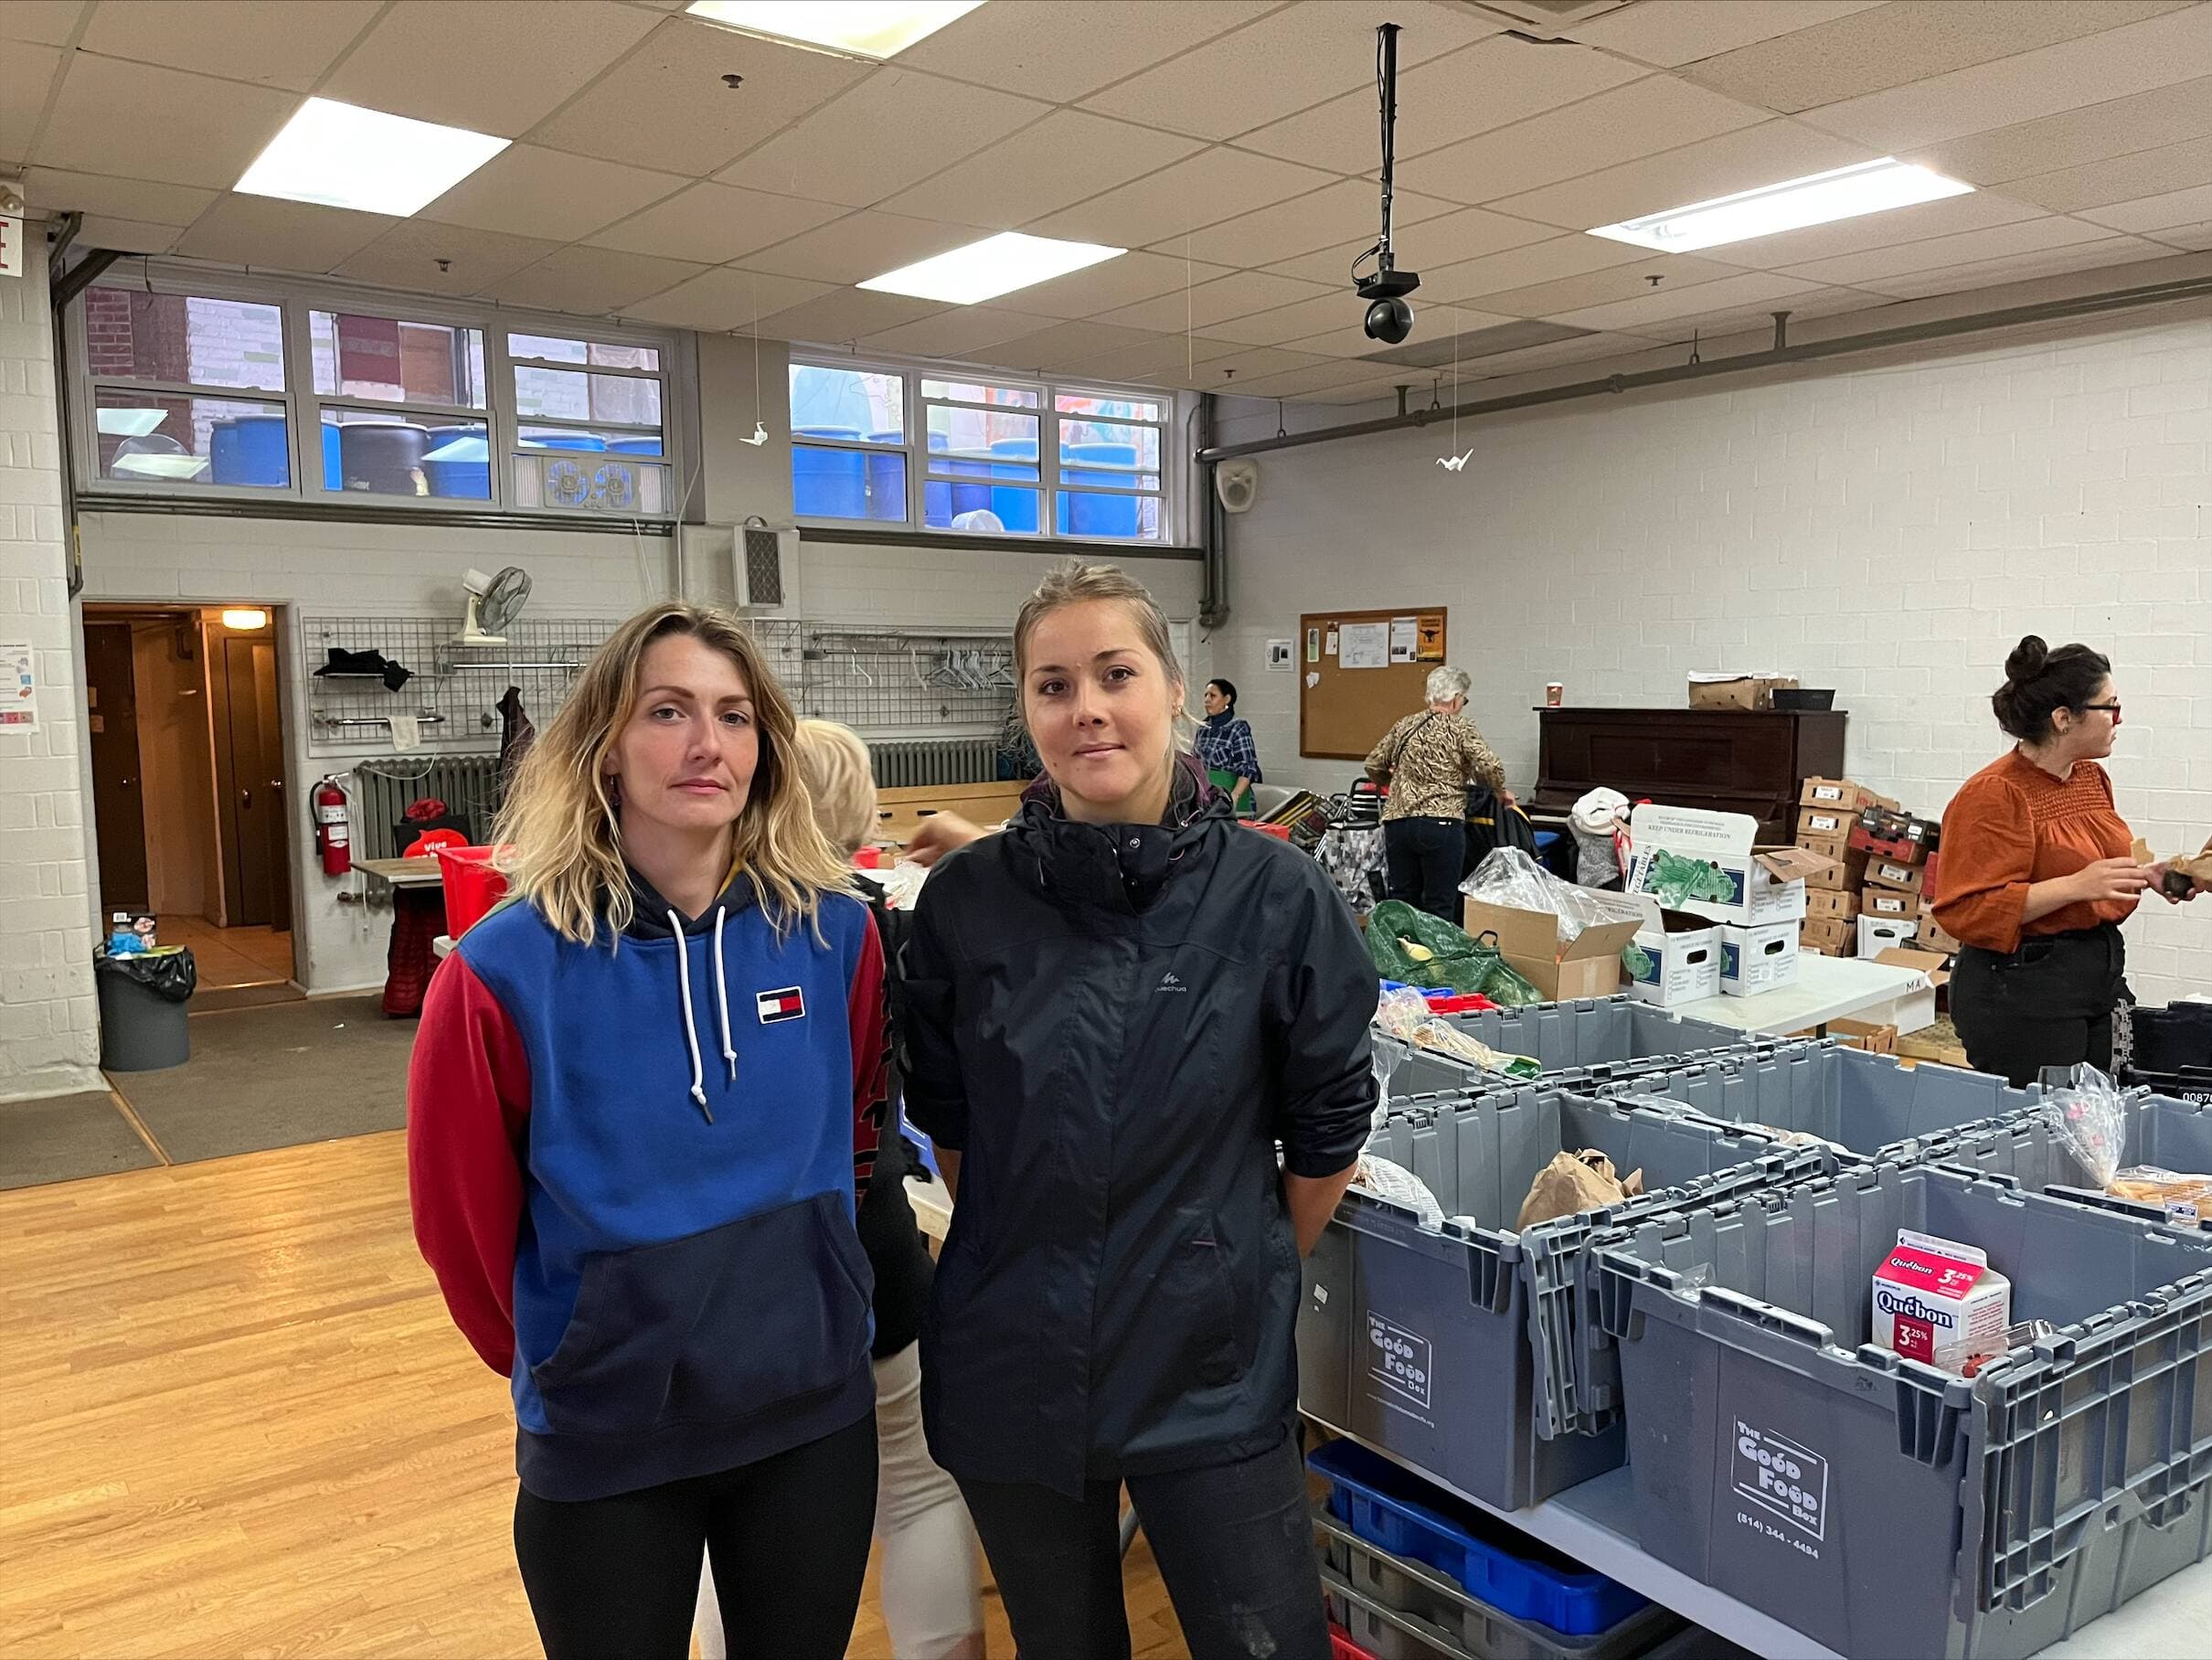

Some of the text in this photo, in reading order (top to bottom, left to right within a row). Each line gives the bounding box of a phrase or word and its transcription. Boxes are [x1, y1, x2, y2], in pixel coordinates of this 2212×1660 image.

[1632, 846, 1652, 894] EGETABLES
[1890, 1257, 1934, 1275] Québon
[1369, 1316, 1386, 1331] THE
[1877, 1291, 1952, 1328] Québon
[1369, 1328, 1414, 1359] GOOD
[1385, 1352, 1425, 1383] FOOD
[1737, 1420, 1761, 1441] THE
[1738, 1436, 1801, 1480] GOOD
[1759, 1465, 1818, 1511] FOOD
[1737, 1512, 1764, 1533] (514)
[1765, 1526, 1785, 1542] 344
